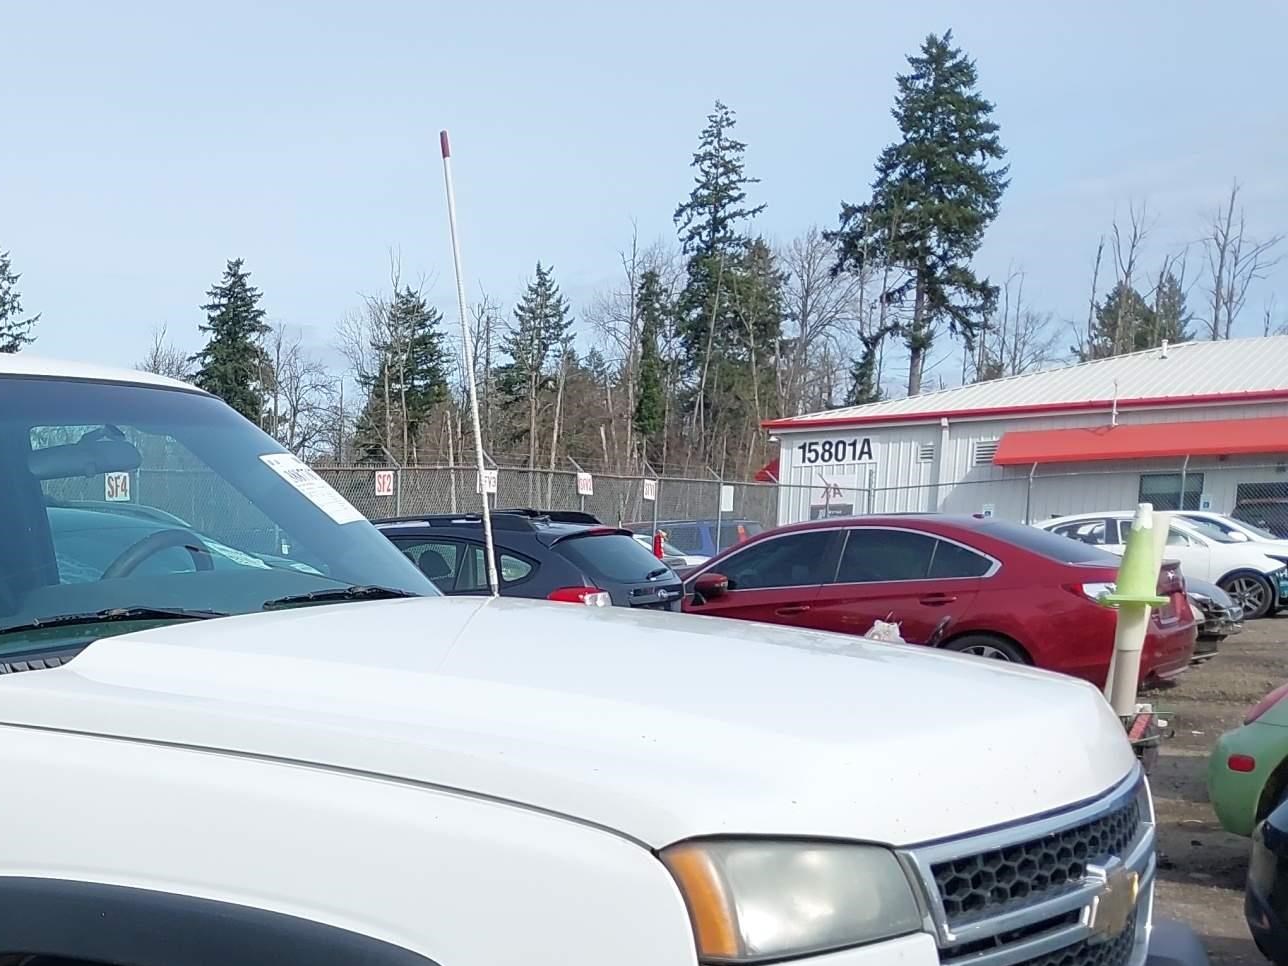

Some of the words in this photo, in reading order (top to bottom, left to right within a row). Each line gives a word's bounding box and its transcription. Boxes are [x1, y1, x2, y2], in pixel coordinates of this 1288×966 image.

[798, 438, 873, 464] 15801A
[107, 475, 128, 498] SF4
[377, 474, 391, 493] SF2
